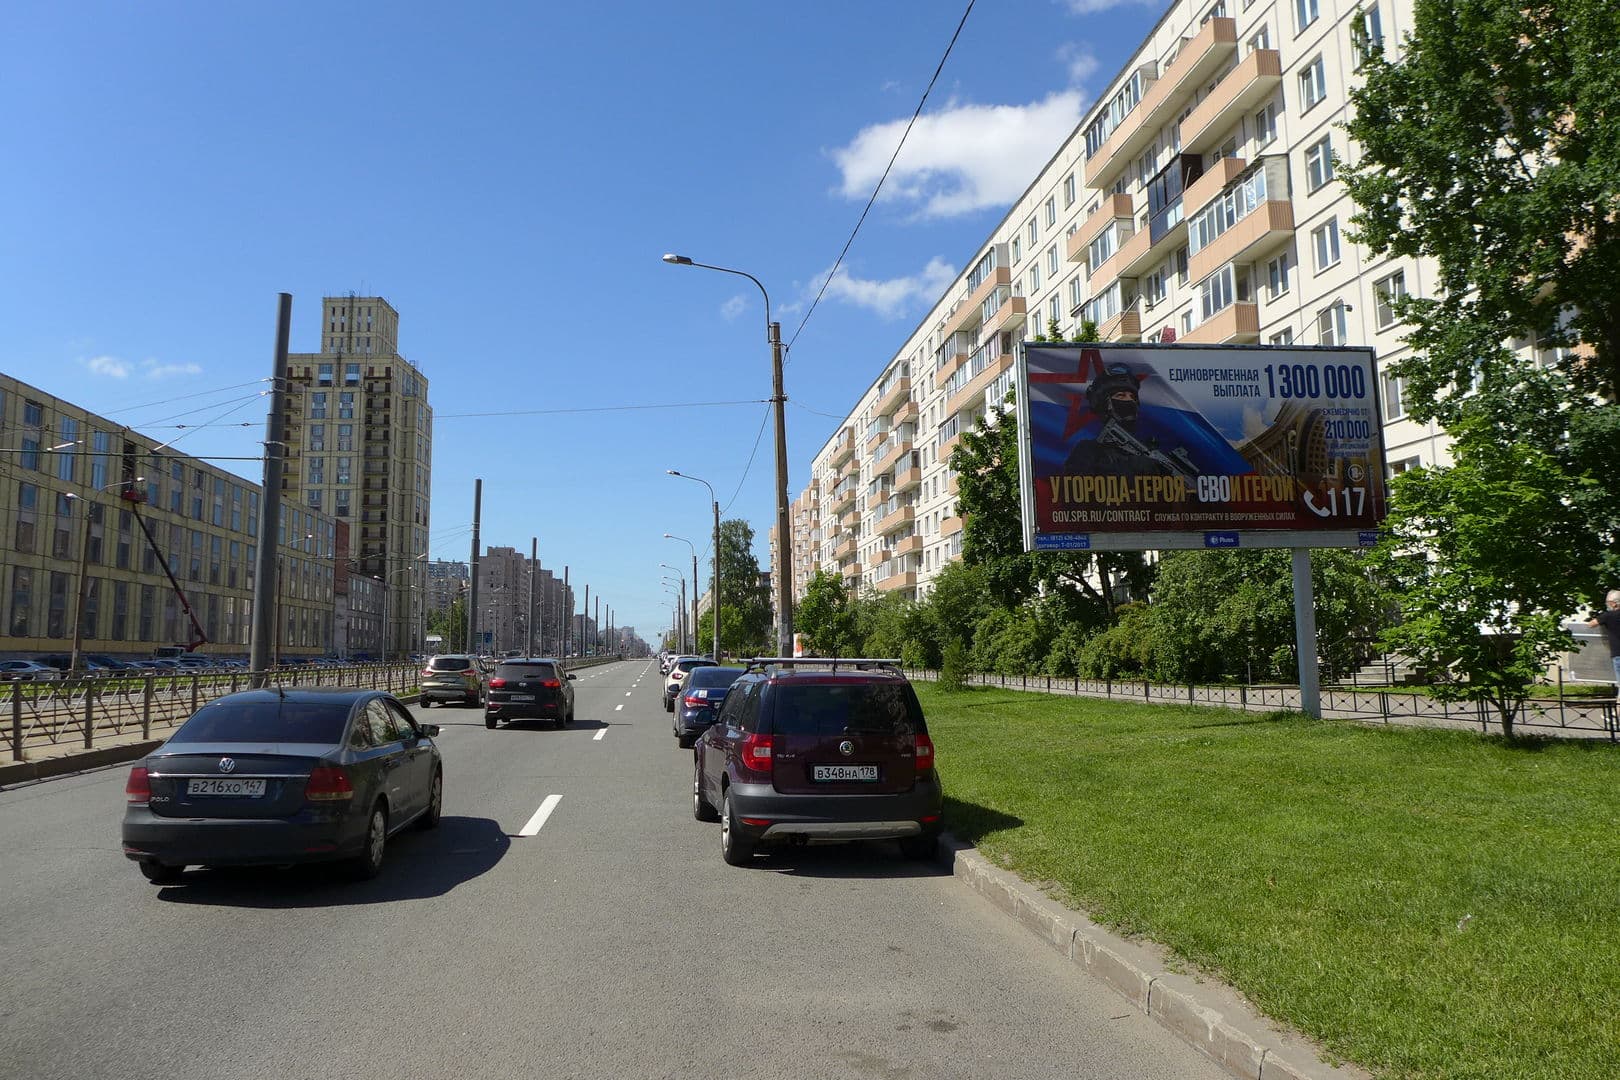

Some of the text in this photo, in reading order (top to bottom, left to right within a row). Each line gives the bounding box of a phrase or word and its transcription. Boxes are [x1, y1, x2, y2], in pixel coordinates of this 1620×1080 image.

[1169, 368, 1259, 382] ЕДИНОВРЕМЕННАЯ
[1324, 364, 1366, 399] 000
[1213, 385, 1260, 398] ВЫПЛАТА
[1325, 420, 1370, 439] 210 000
[1050, 475, 1060, 503] У
[1063, 475, 1186, 506] ГОРОДА-ГЕРОЯ
[1197, 475, 1241, 503] СВОИ
[1244, 475, 1296, 502] ГЕРОИ
[1327, 487, 1365, 516] 117
[1052, 510, 1151, 523] GOV.SPB.RU/CONTRACT
[1154, 512, 1180, 522] СЛУЖБА
[1190, 512, 1224, 521] КОНТРАКТУ
[1224, 512, 1229, 521] В
[1230, 512, 1274, 521] ВООРУЖЕННЫХ
[1275, 512, 1296, 521] СИЛАХ
[860, 767, 875, 777] 178
